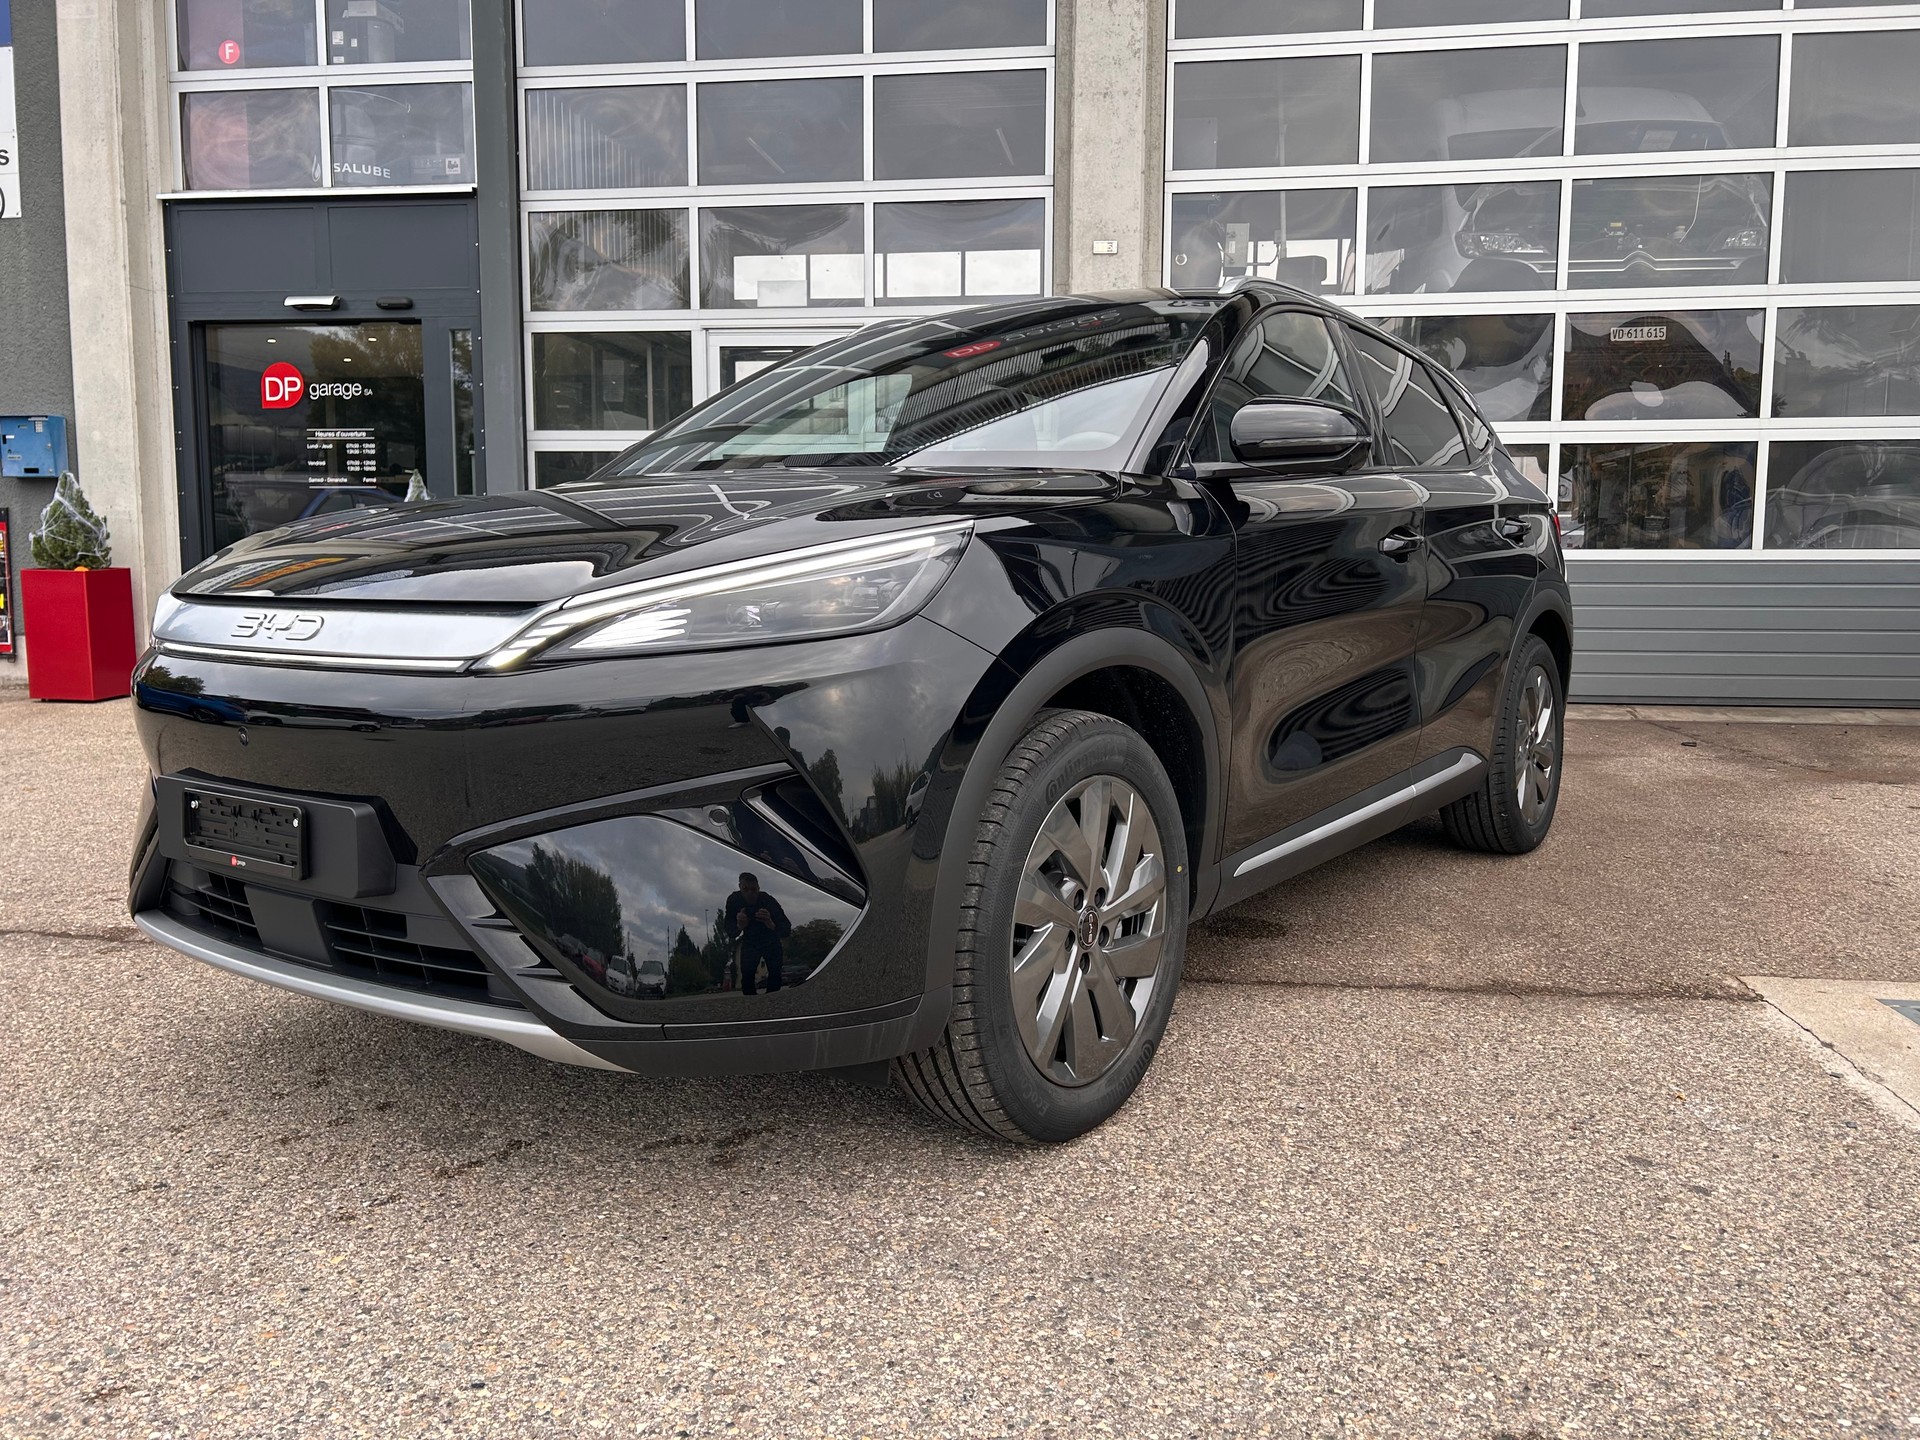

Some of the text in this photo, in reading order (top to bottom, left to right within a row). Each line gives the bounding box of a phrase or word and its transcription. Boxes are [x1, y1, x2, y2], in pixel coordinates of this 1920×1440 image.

[225, 42, 234, 60] F
[264, 376, 301, 402] DP
[309, 382, 362, 400] garage
[230, 611, 325, 642] BYD
